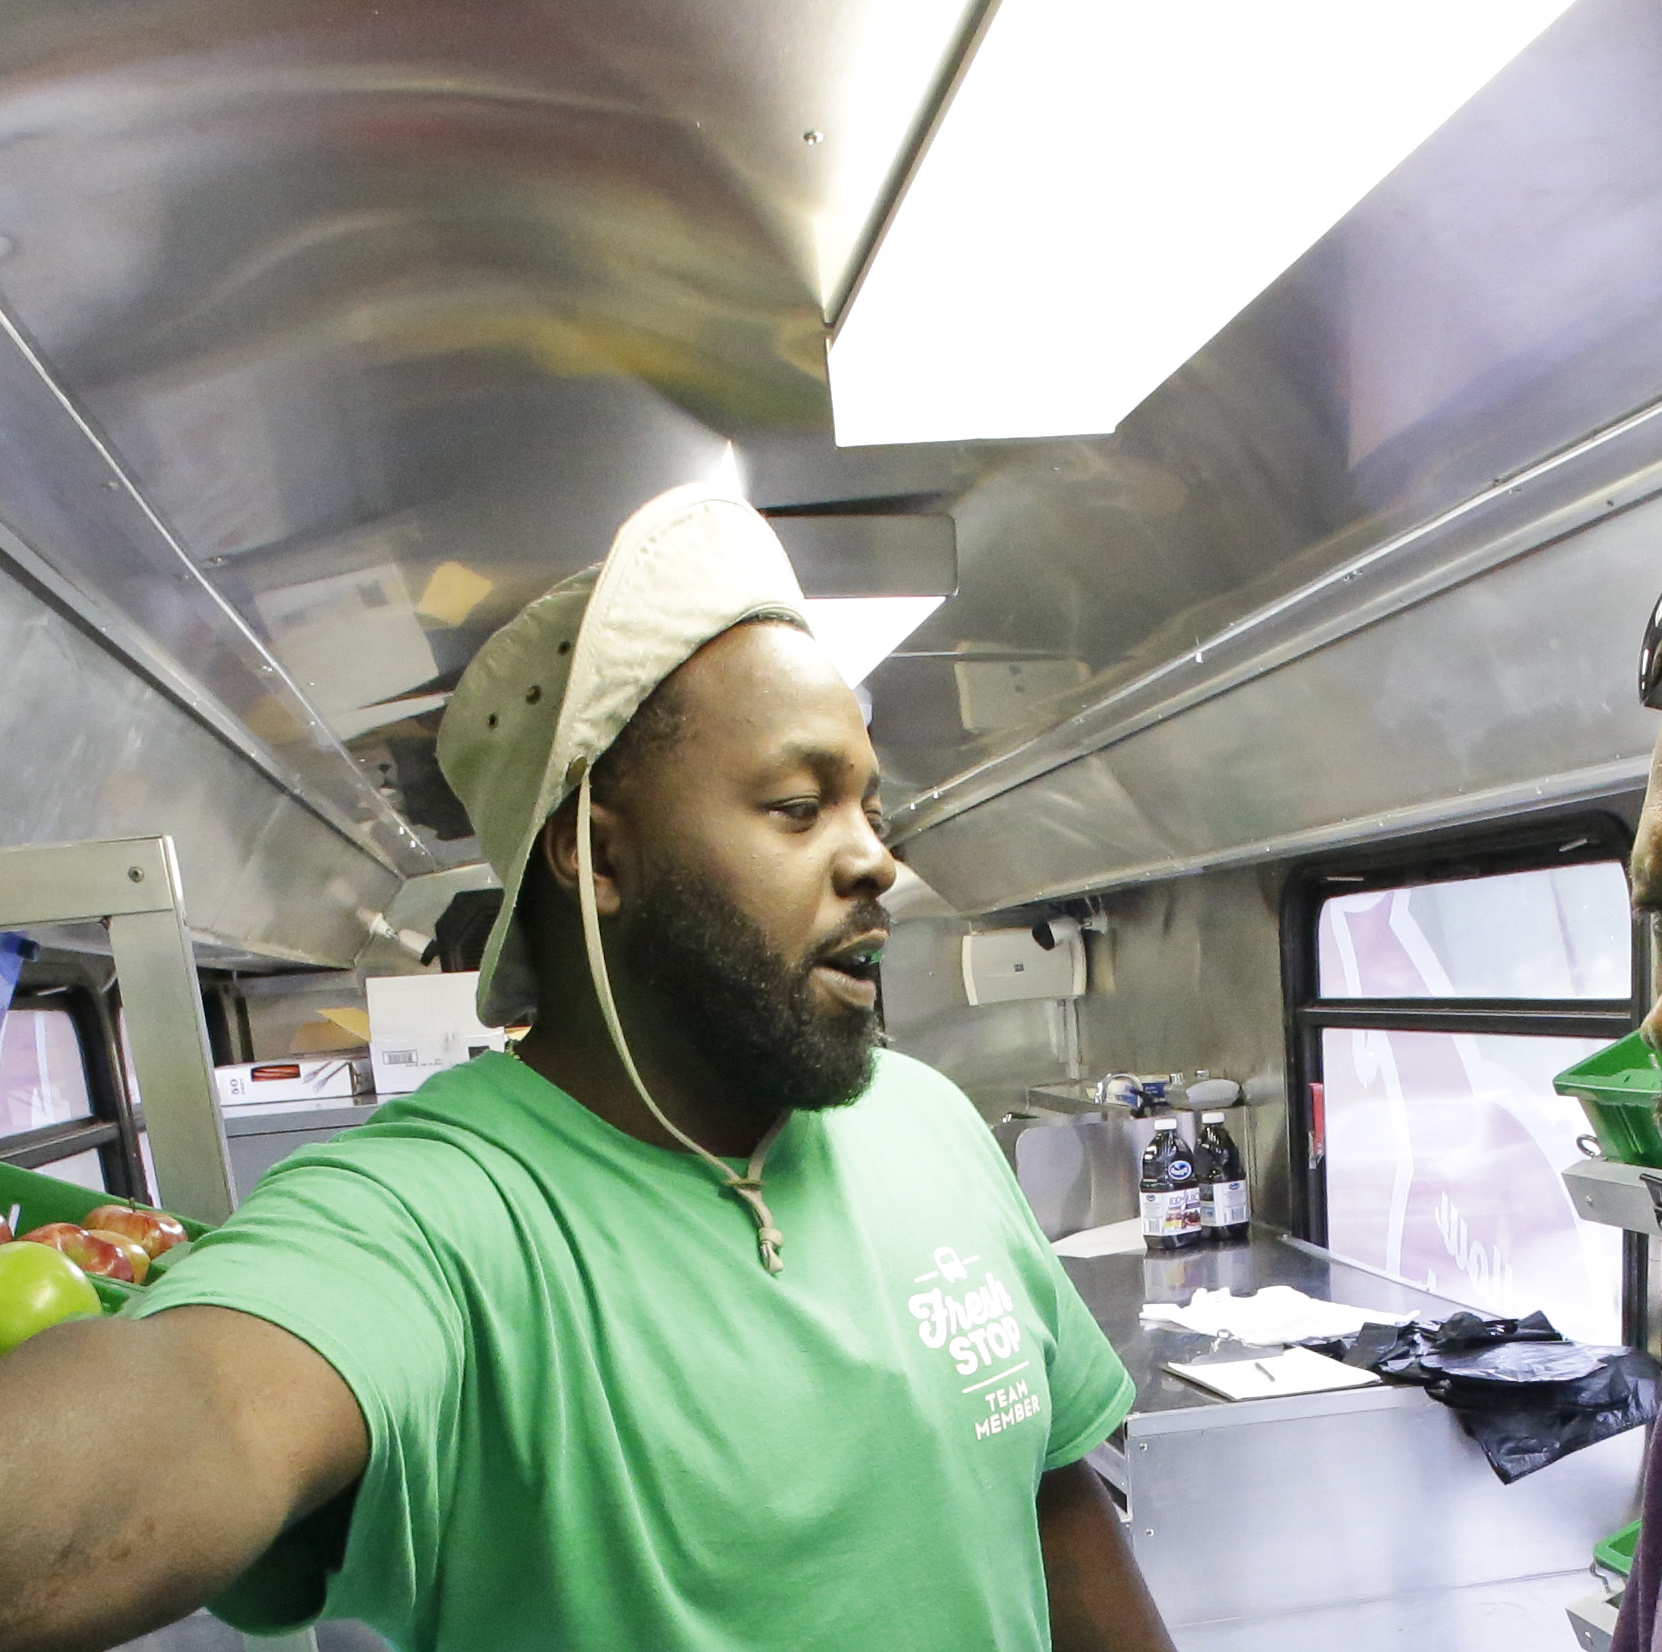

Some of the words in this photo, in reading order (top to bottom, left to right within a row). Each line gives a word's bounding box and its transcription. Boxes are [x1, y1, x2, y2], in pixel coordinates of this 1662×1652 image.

[907, 1272, 1014, 1349] Fresh
[949, 1316, 1021, 1376] STOP
[974, 1394, 1041, 1440] MEMBER
[985, 1379, 1029, 1412] TEAM
